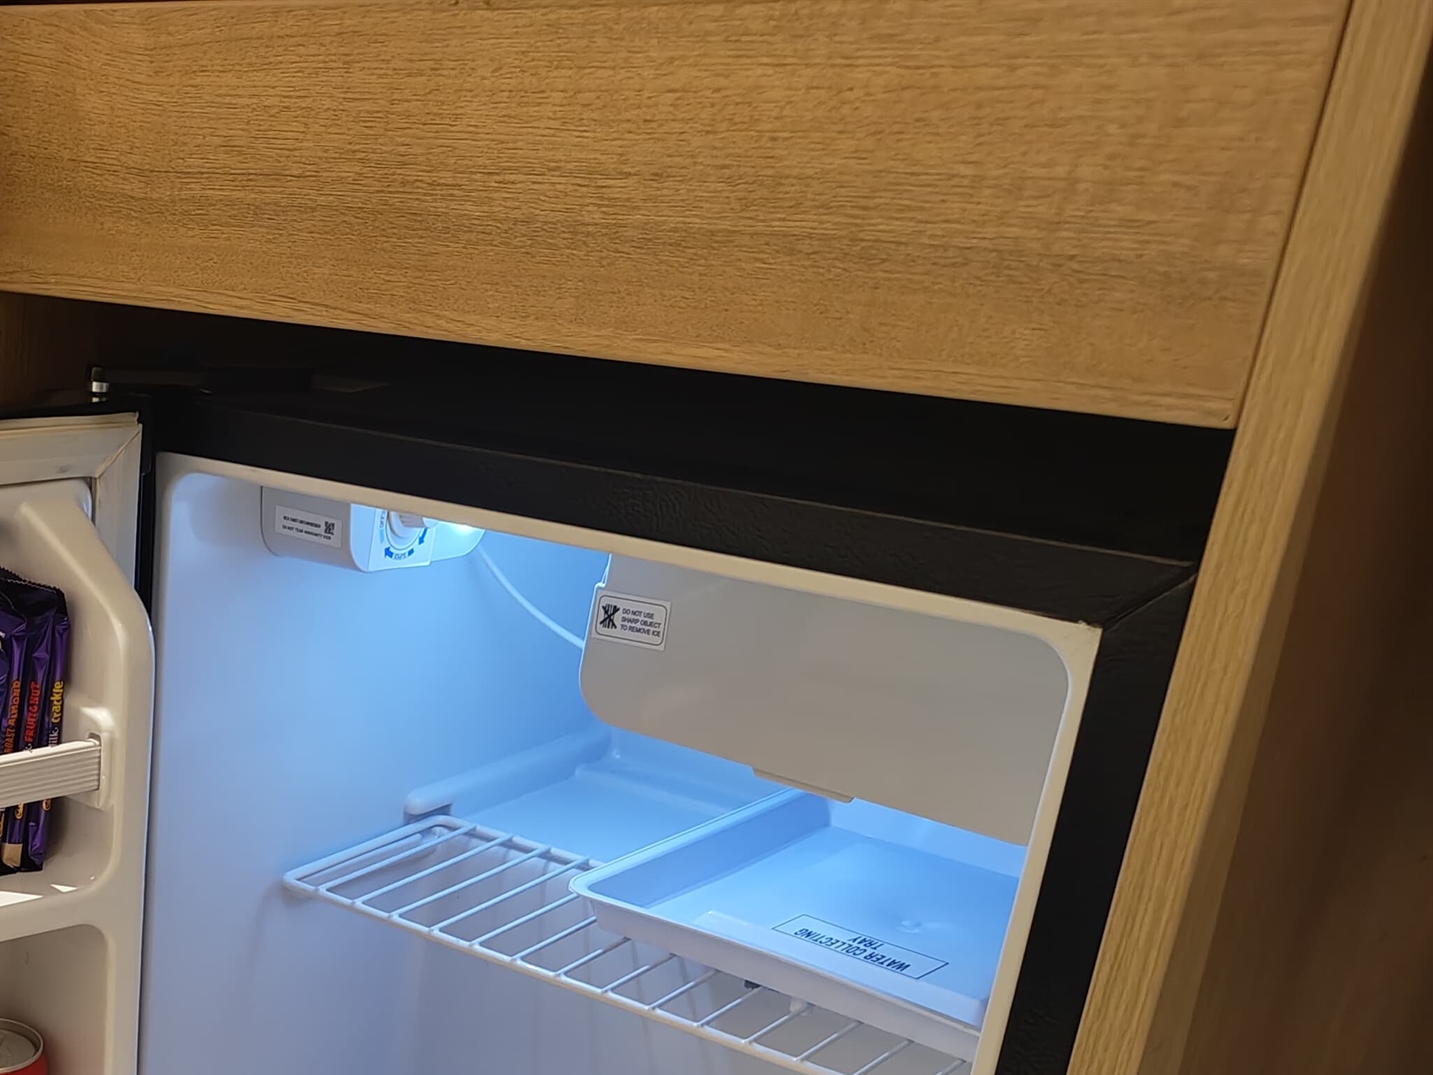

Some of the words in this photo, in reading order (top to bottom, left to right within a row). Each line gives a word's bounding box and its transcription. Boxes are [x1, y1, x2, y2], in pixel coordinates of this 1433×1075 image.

[621, 616, 640, 624] SHARP
[640, 620, 662, 628] OBJECT
[631, 609, 643, 617] NOT
[628, 626, 651, 635] REMOVE
[8, 680, 21, 726] ALMOND
[50, 681, 64, 724] crackle
[794, 927, 867, 957] COLLECTING
[849, 935, 885, 950] TRAY
[866, 951, 911, 972] WATER
